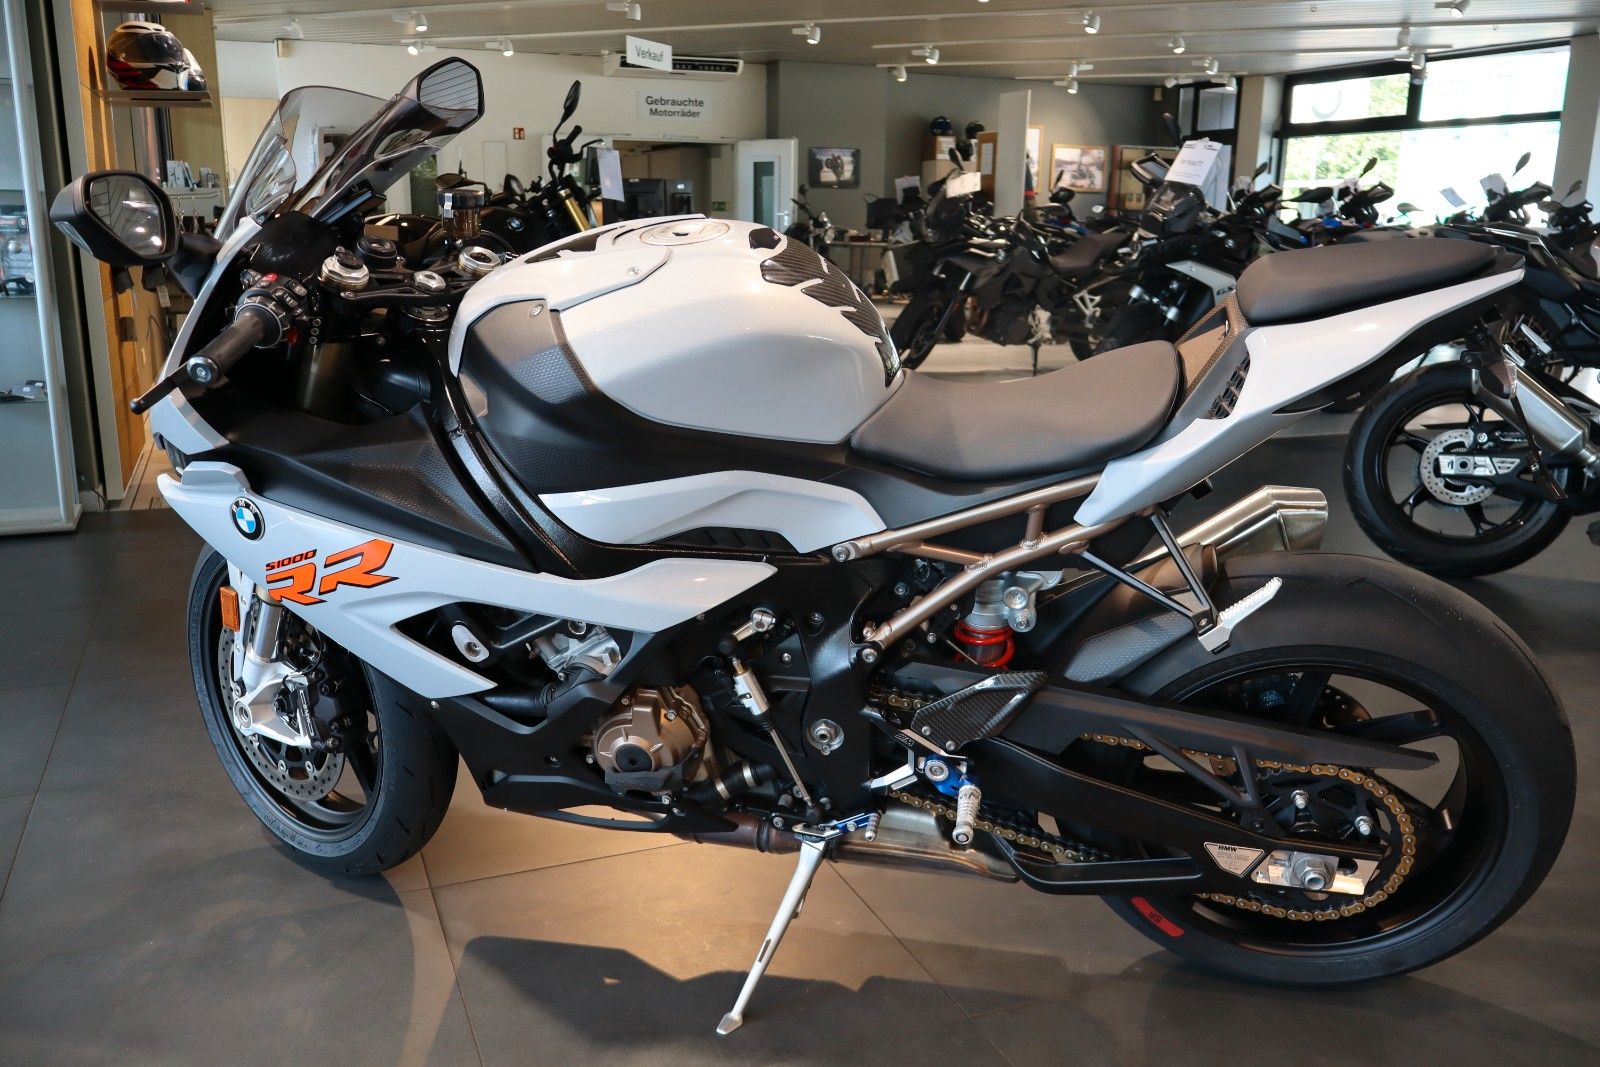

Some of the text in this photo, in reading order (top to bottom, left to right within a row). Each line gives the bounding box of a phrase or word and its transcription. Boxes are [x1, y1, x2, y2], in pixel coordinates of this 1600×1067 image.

[635, 44, 664, 63] Verkauf
[645, 95, 705, 108] Gebrauchte
[649, 108, 701, 118] Motorräder
[266, 549, 317, 571] S1000
[266, 539, 400, 606] RR
